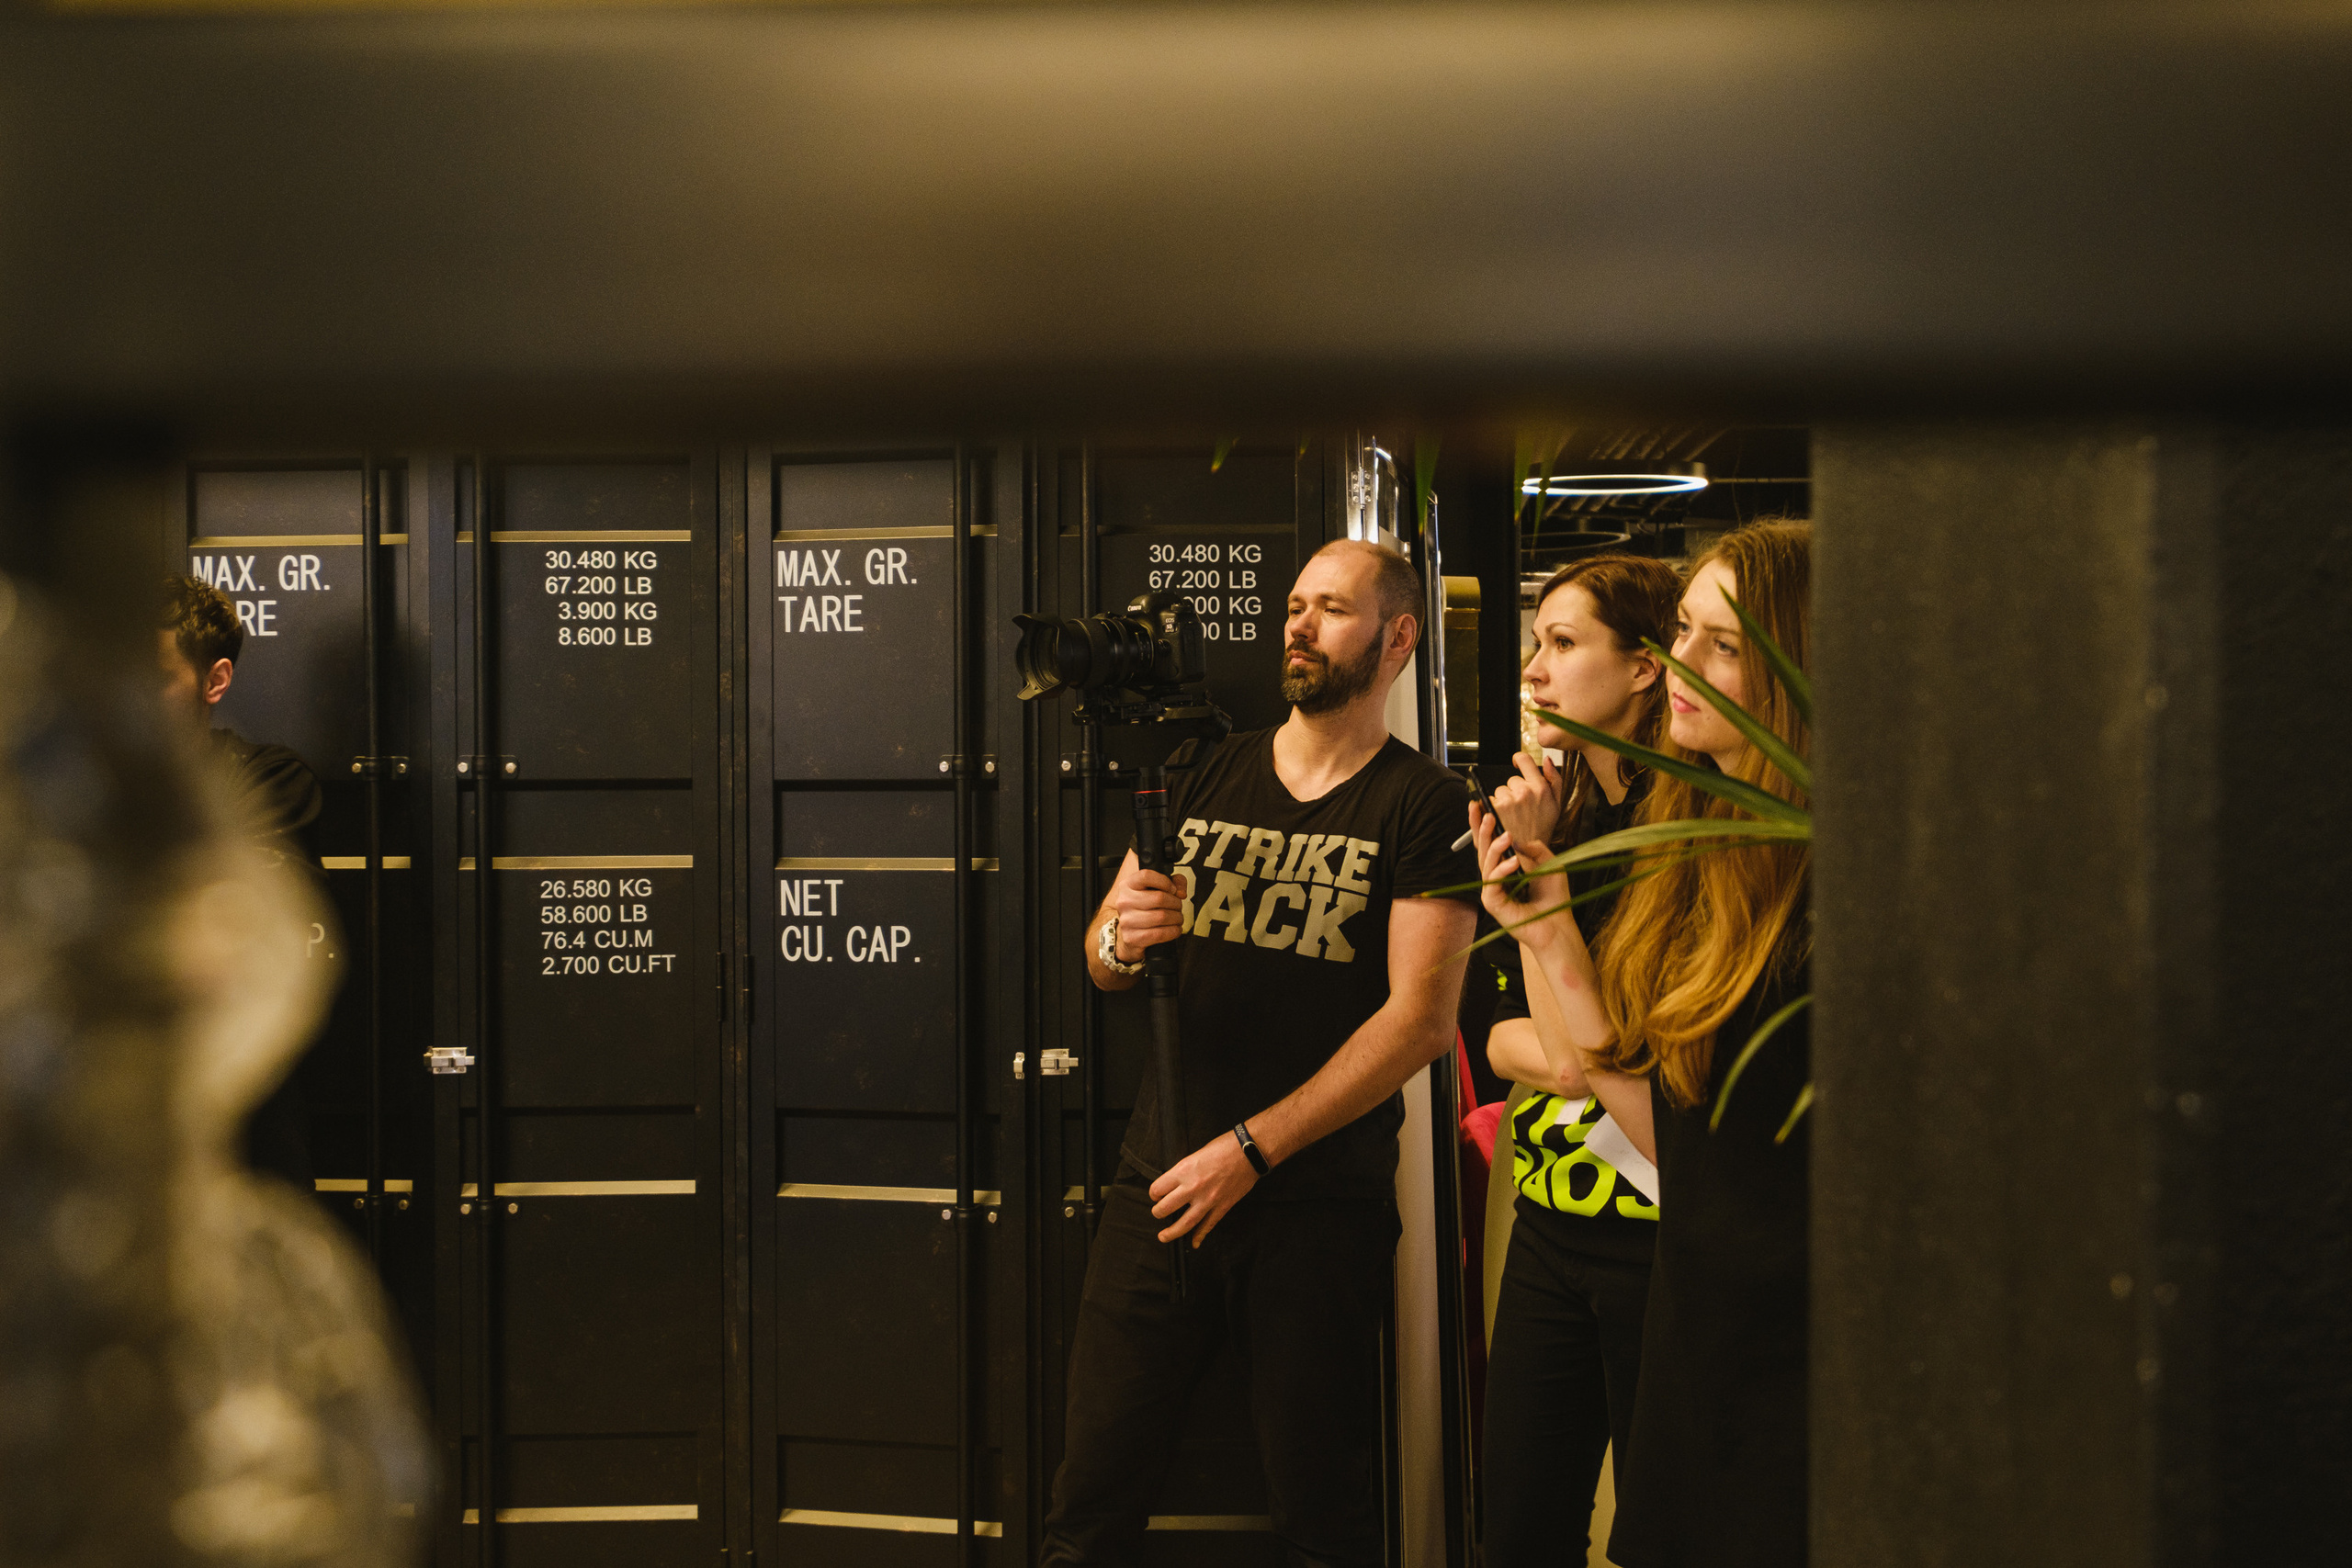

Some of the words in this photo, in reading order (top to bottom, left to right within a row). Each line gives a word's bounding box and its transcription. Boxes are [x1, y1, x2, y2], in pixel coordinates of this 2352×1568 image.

[545, 551, 616, 570] 30.480
[624, 551, 658, 570] KG
[1148, 545, 1220, 563] 30.480
[1229, 545, 1261, 563] KG
[193, 556, 266, 592] MAX.
[277, 555, 333, 591] GR.
[776, 548, 852, 588] MAX.
[864, 547, 918, 586] GR.
[545, 576, 616, 595] 67.200
[624, 576, 652, 595] LB
[1148, 570, 1220, 589] 67.200
[1229, 570, 1257, 589] LB
[558, 602, 616, 620] 3.900
[624, 602, 658, 620] KG
[777, 594, 865, 633] TARE
[1229, 596, 1262, 615] KG
[235, 600, 278, 637] RE
[558, 627, 616, 646] 8.600
[624, 627, 652, 646] LB
[1229, 622, 1257, 641] LB
[1173, 818, 1379, 895] STRIKE
[540, 879, 611, 899] 26.580
[619, 878, 652, 897] KG
[780, 879, 844, 917] NET
[540, 904, 612, 924] 58.600
[619, 904, 648, 923] LB
[306, 921, 334, 959] P.
[541, 931, 586, 950] 76.4
[594, 929, 652, 949] CU.M
[781, 925, 833, 963] CU.
[846, 925, 921, 963] CAP.
[542, 955, 600, 976] 2.700
[607, 953, 676, 974] CU.FT
